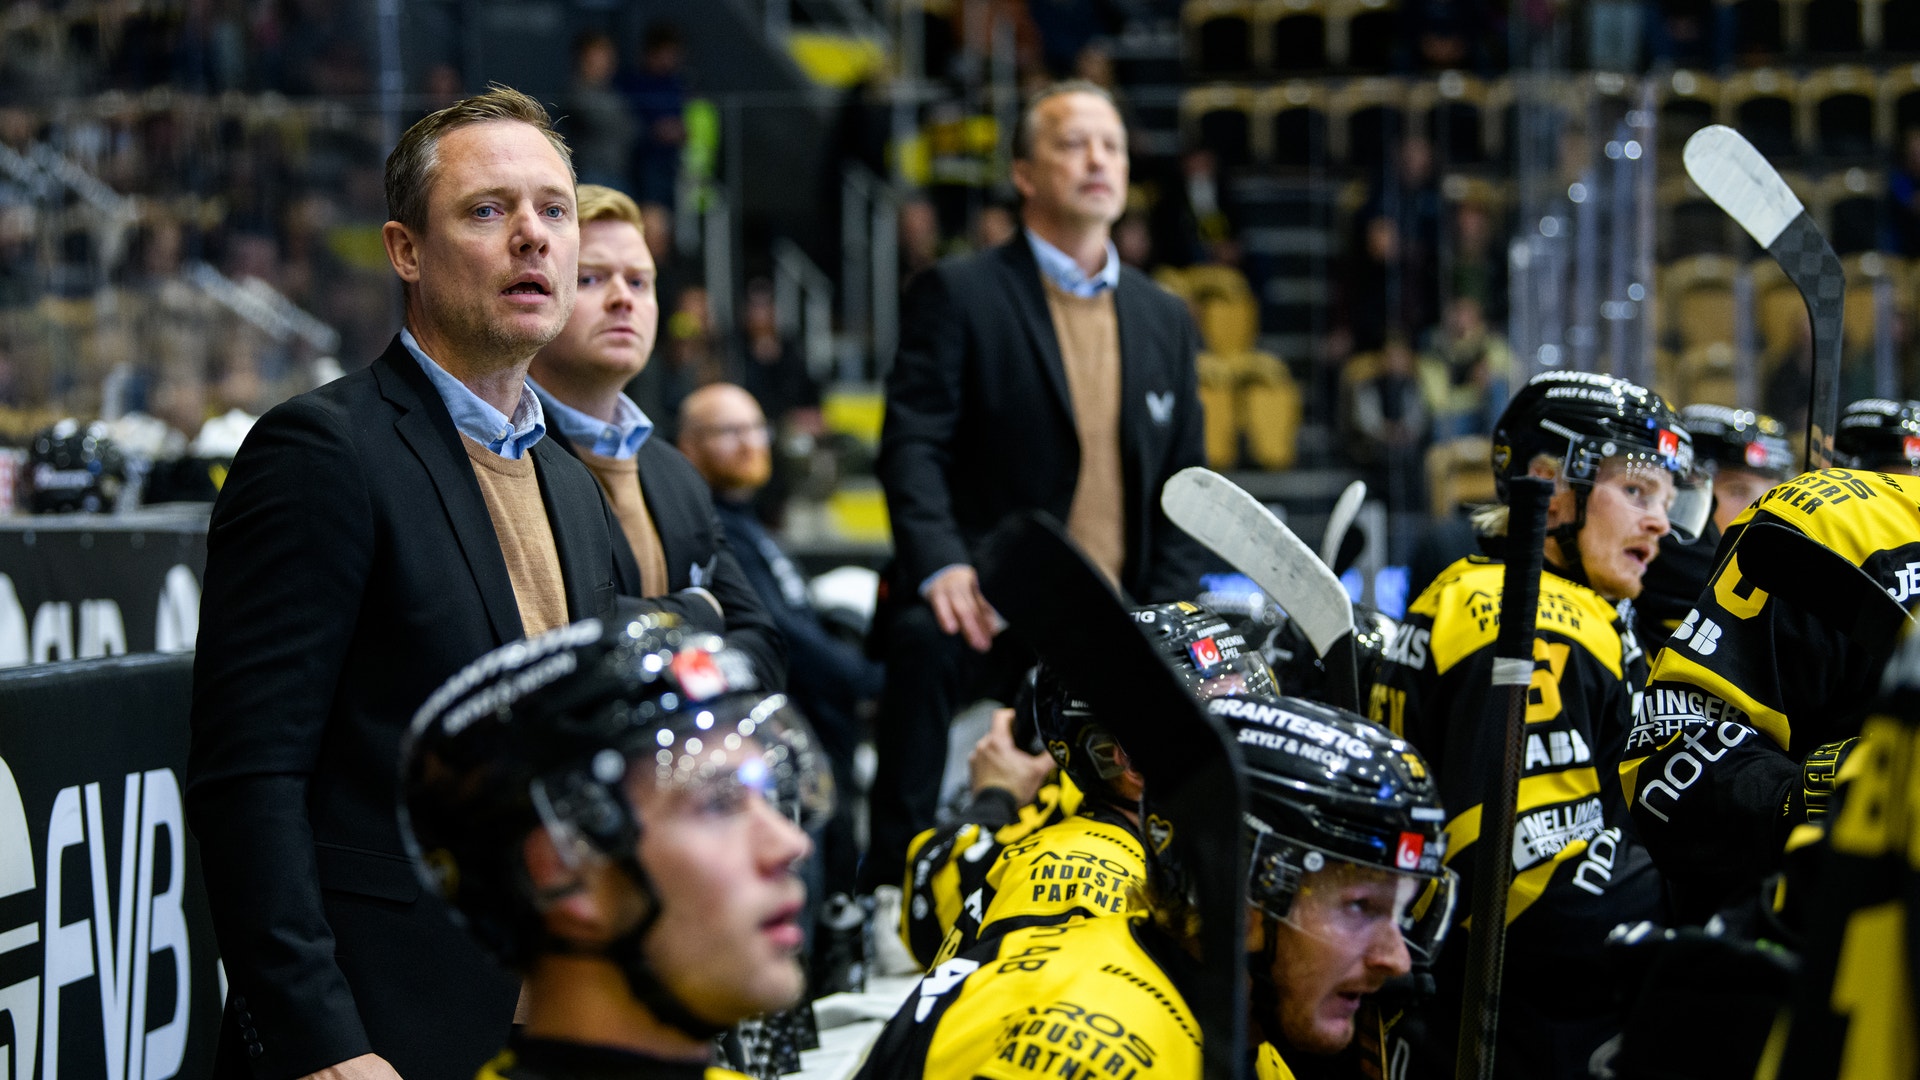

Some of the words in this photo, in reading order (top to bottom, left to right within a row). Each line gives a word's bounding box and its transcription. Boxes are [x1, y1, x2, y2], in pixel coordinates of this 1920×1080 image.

[1672, 608, 1722, 656] BB
[1208, 699, 1374, 759] BRANTESTIG
[1237, 728, 1286, 750] SKYLT
[1283, 738, 1299, 754] &
[1638, 721, 1758, 823] nota
[1030, 865, 1125, 893] INDUST
[1032, 883, 1123, 913] PARTNE
